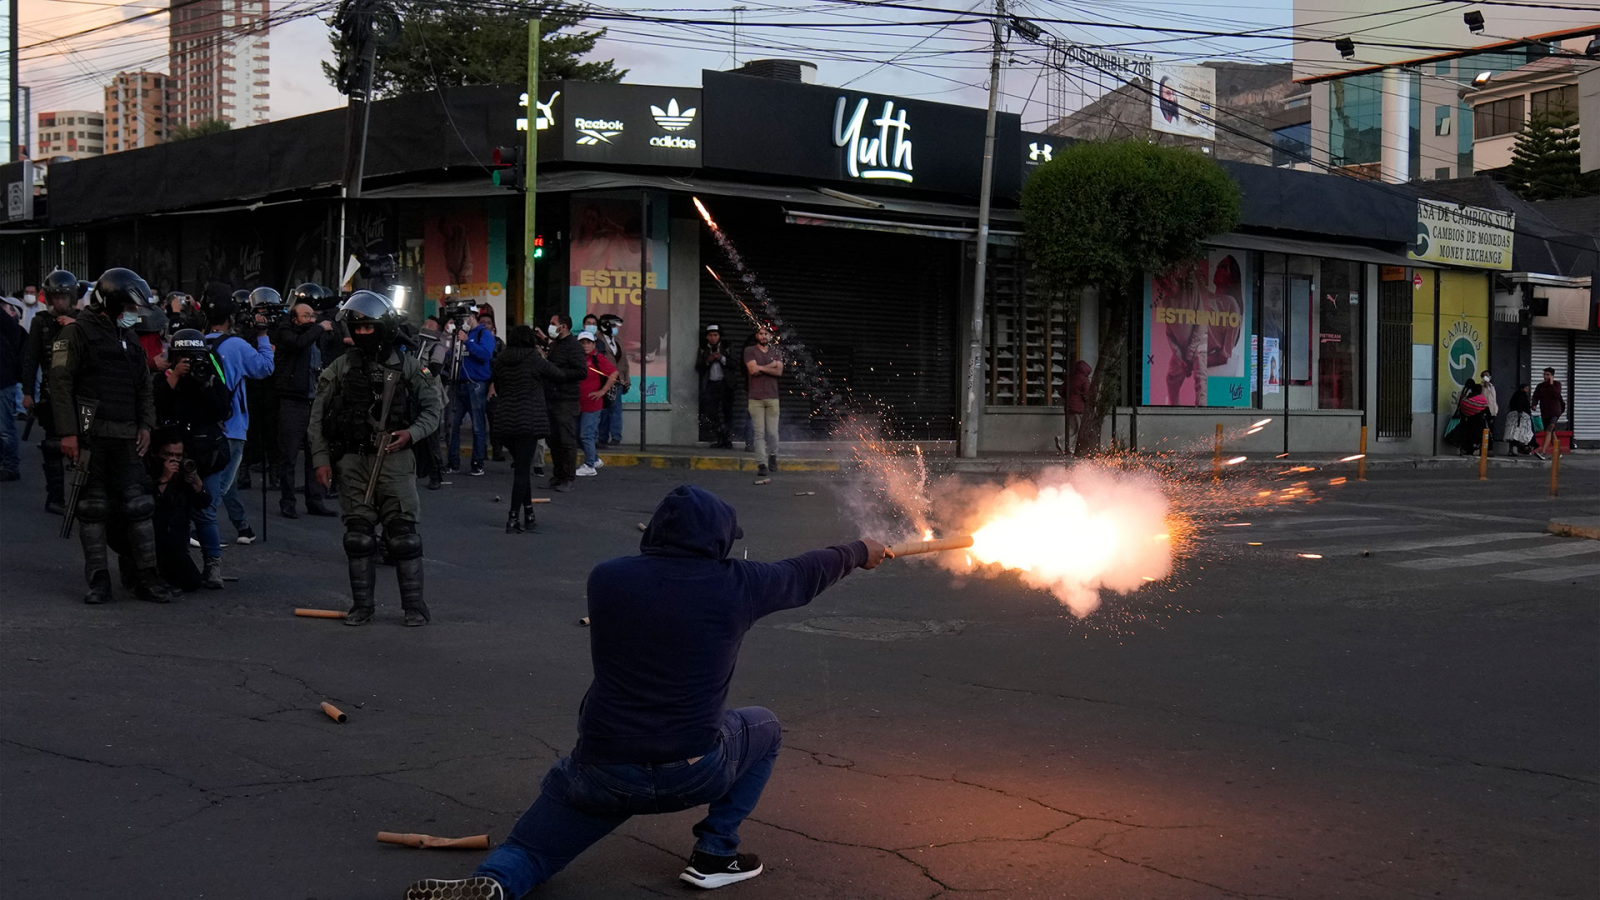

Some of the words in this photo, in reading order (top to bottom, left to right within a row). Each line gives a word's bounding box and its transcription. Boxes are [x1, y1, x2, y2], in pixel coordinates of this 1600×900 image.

[1132, 60, 1152, 77] 706
[575, 117, 624, 131] Reebok
[649, 135, 697, 149] adidas
[833, 96, 914, 178] Yuth
[1437, 205, 1450, 222] DE
[1452, 208, 1493, 229] CAMBIOS
[1432, 225, 1465, 242] CAMBIOS
[1466, 230, 1477, 244] DE
[1477, 232, 1511, 248] MONEDAS
[1439, 245, 1465, 260] MONEY
[1466, 248, 1503, 265] EXCHANGE
[580, 269, 657, 288] ESTRE
[174, 339, 205, 348] PRENSA
[1442, 321, 1483, 351] CAMBIOS
